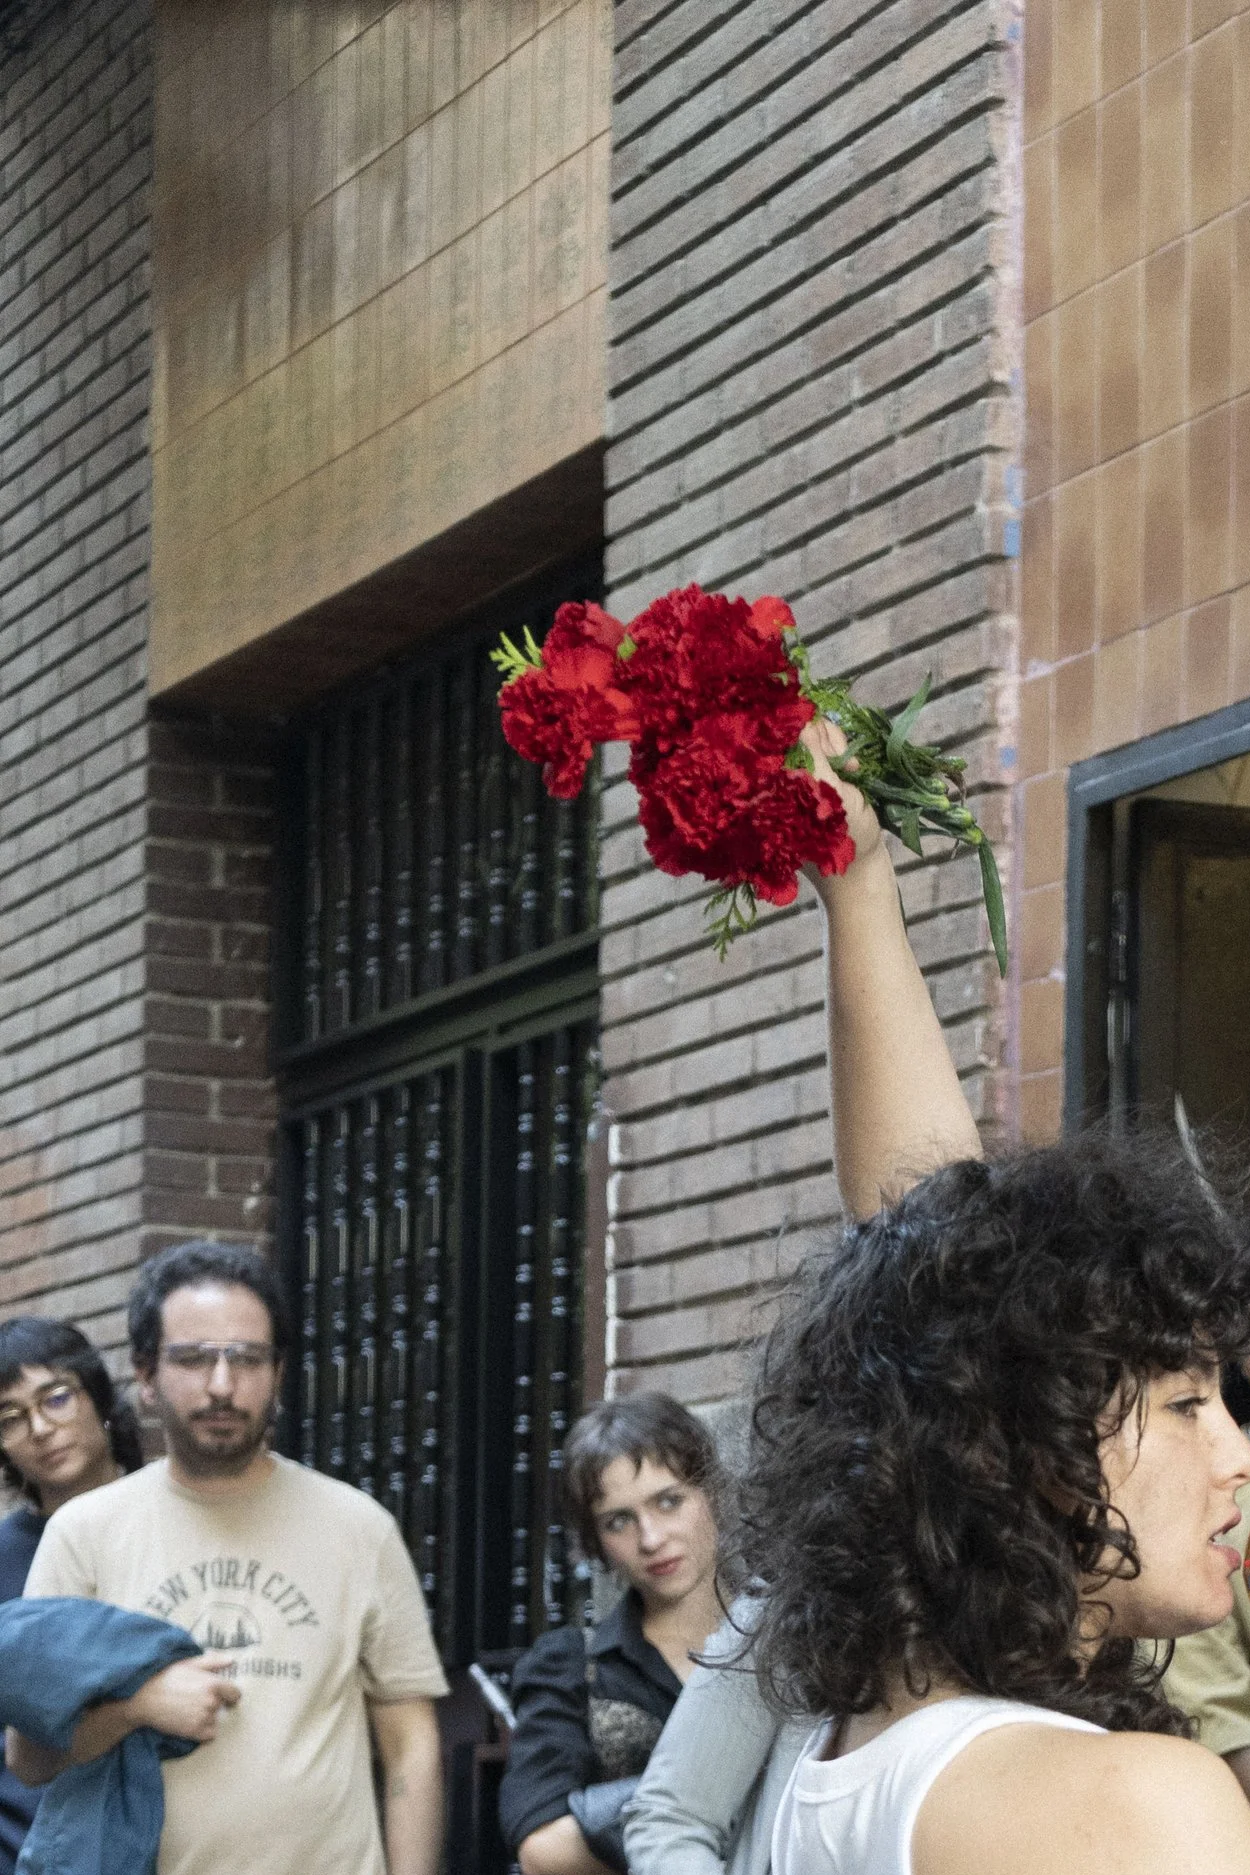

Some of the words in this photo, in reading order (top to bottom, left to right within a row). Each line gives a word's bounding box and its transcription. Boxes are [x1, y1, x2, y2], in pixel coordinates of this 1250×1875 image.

[145, 1573, 189, 1618] EW
[190, 1556, 261, 1592] YORK
[261, 1570, 320, 1627] CITY
